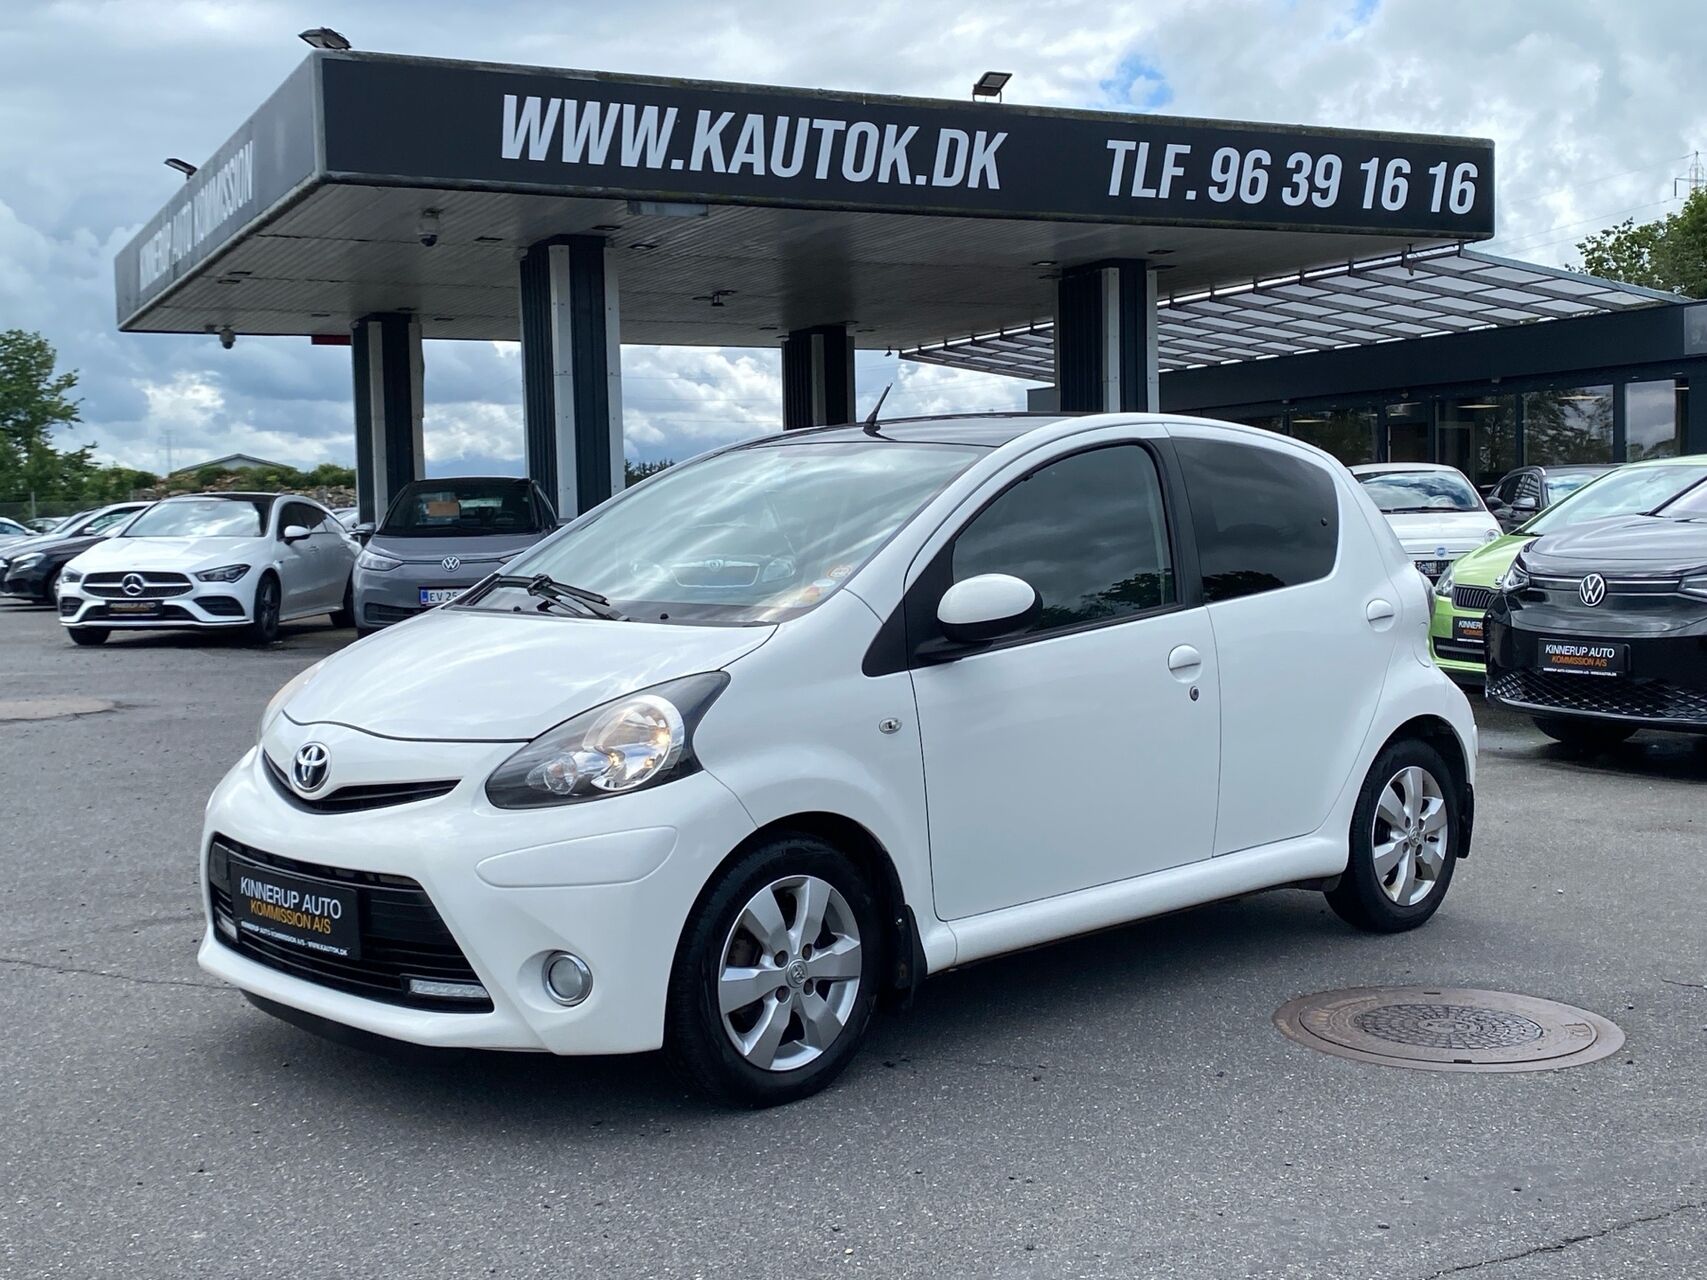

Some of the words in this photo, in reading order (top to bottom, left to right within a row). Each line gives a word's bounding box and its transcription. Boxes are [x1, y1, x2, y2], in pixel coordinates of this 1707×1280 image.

[501, 94, 1008, 190] WWW.KAUTOK.DK
[1107, 140, 1196, 200] TLF.
[1207, 146, 1272, 205] 96
[1281, 151, 1343, 208] 39
[1359, 156, 1411, 211] 16
[1427, 161, 1479, 215] 16
[430, 592, 443, 601] EV
[1545, 644, 1588, 656] KINNERUP
[1588, 647, 1615, 659] AUTO
[1551, 655, 1596, 666] KOMMISSION
[1595, 658, 1609, 667] A/S
[240, 877, 299, 908] KINNERUP
[302, 894, 342, 919] AUTO
[250, 901, 311, 929] KOMMISSION
[313, 916, 332, 935] A/S
